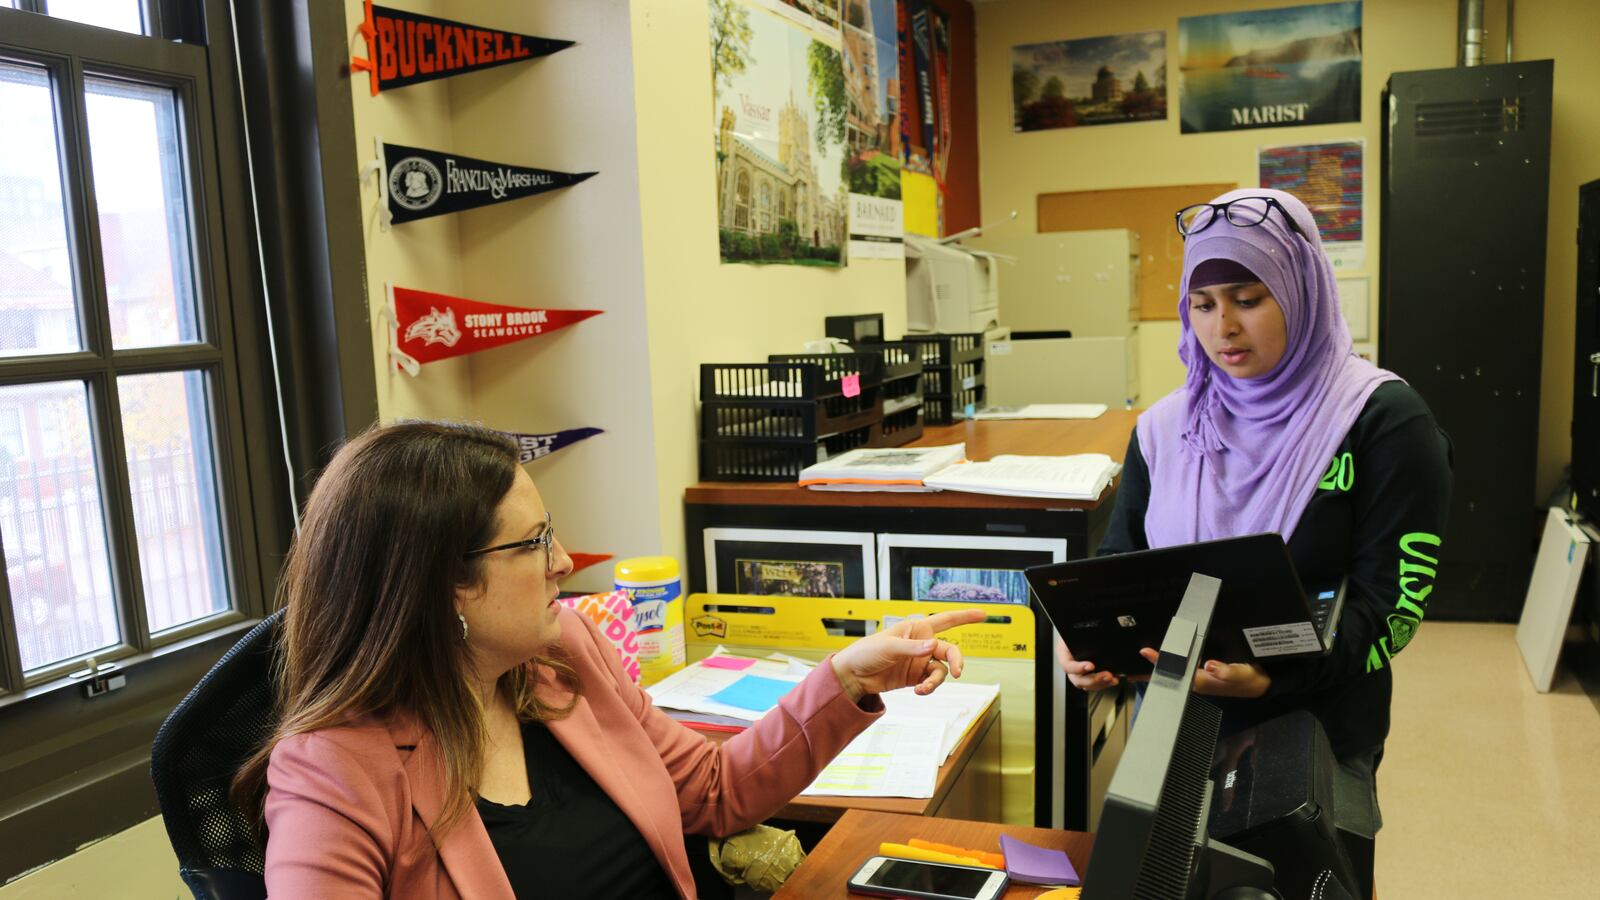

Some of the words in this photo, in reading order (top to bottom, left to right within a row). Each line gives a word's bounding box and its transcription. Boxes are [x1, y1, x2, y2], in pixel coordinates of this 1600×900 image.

[376, 16, 529, 81] BUCKNELL
[1231, 103, 1309, 126] MARIST
[464, 314, 504, 329] STONY
[505, 310, 548, 325] BROOK
[473, 325, 542, 338] SEAWOLVES
[1012, 643, 1028, 652] 3M
